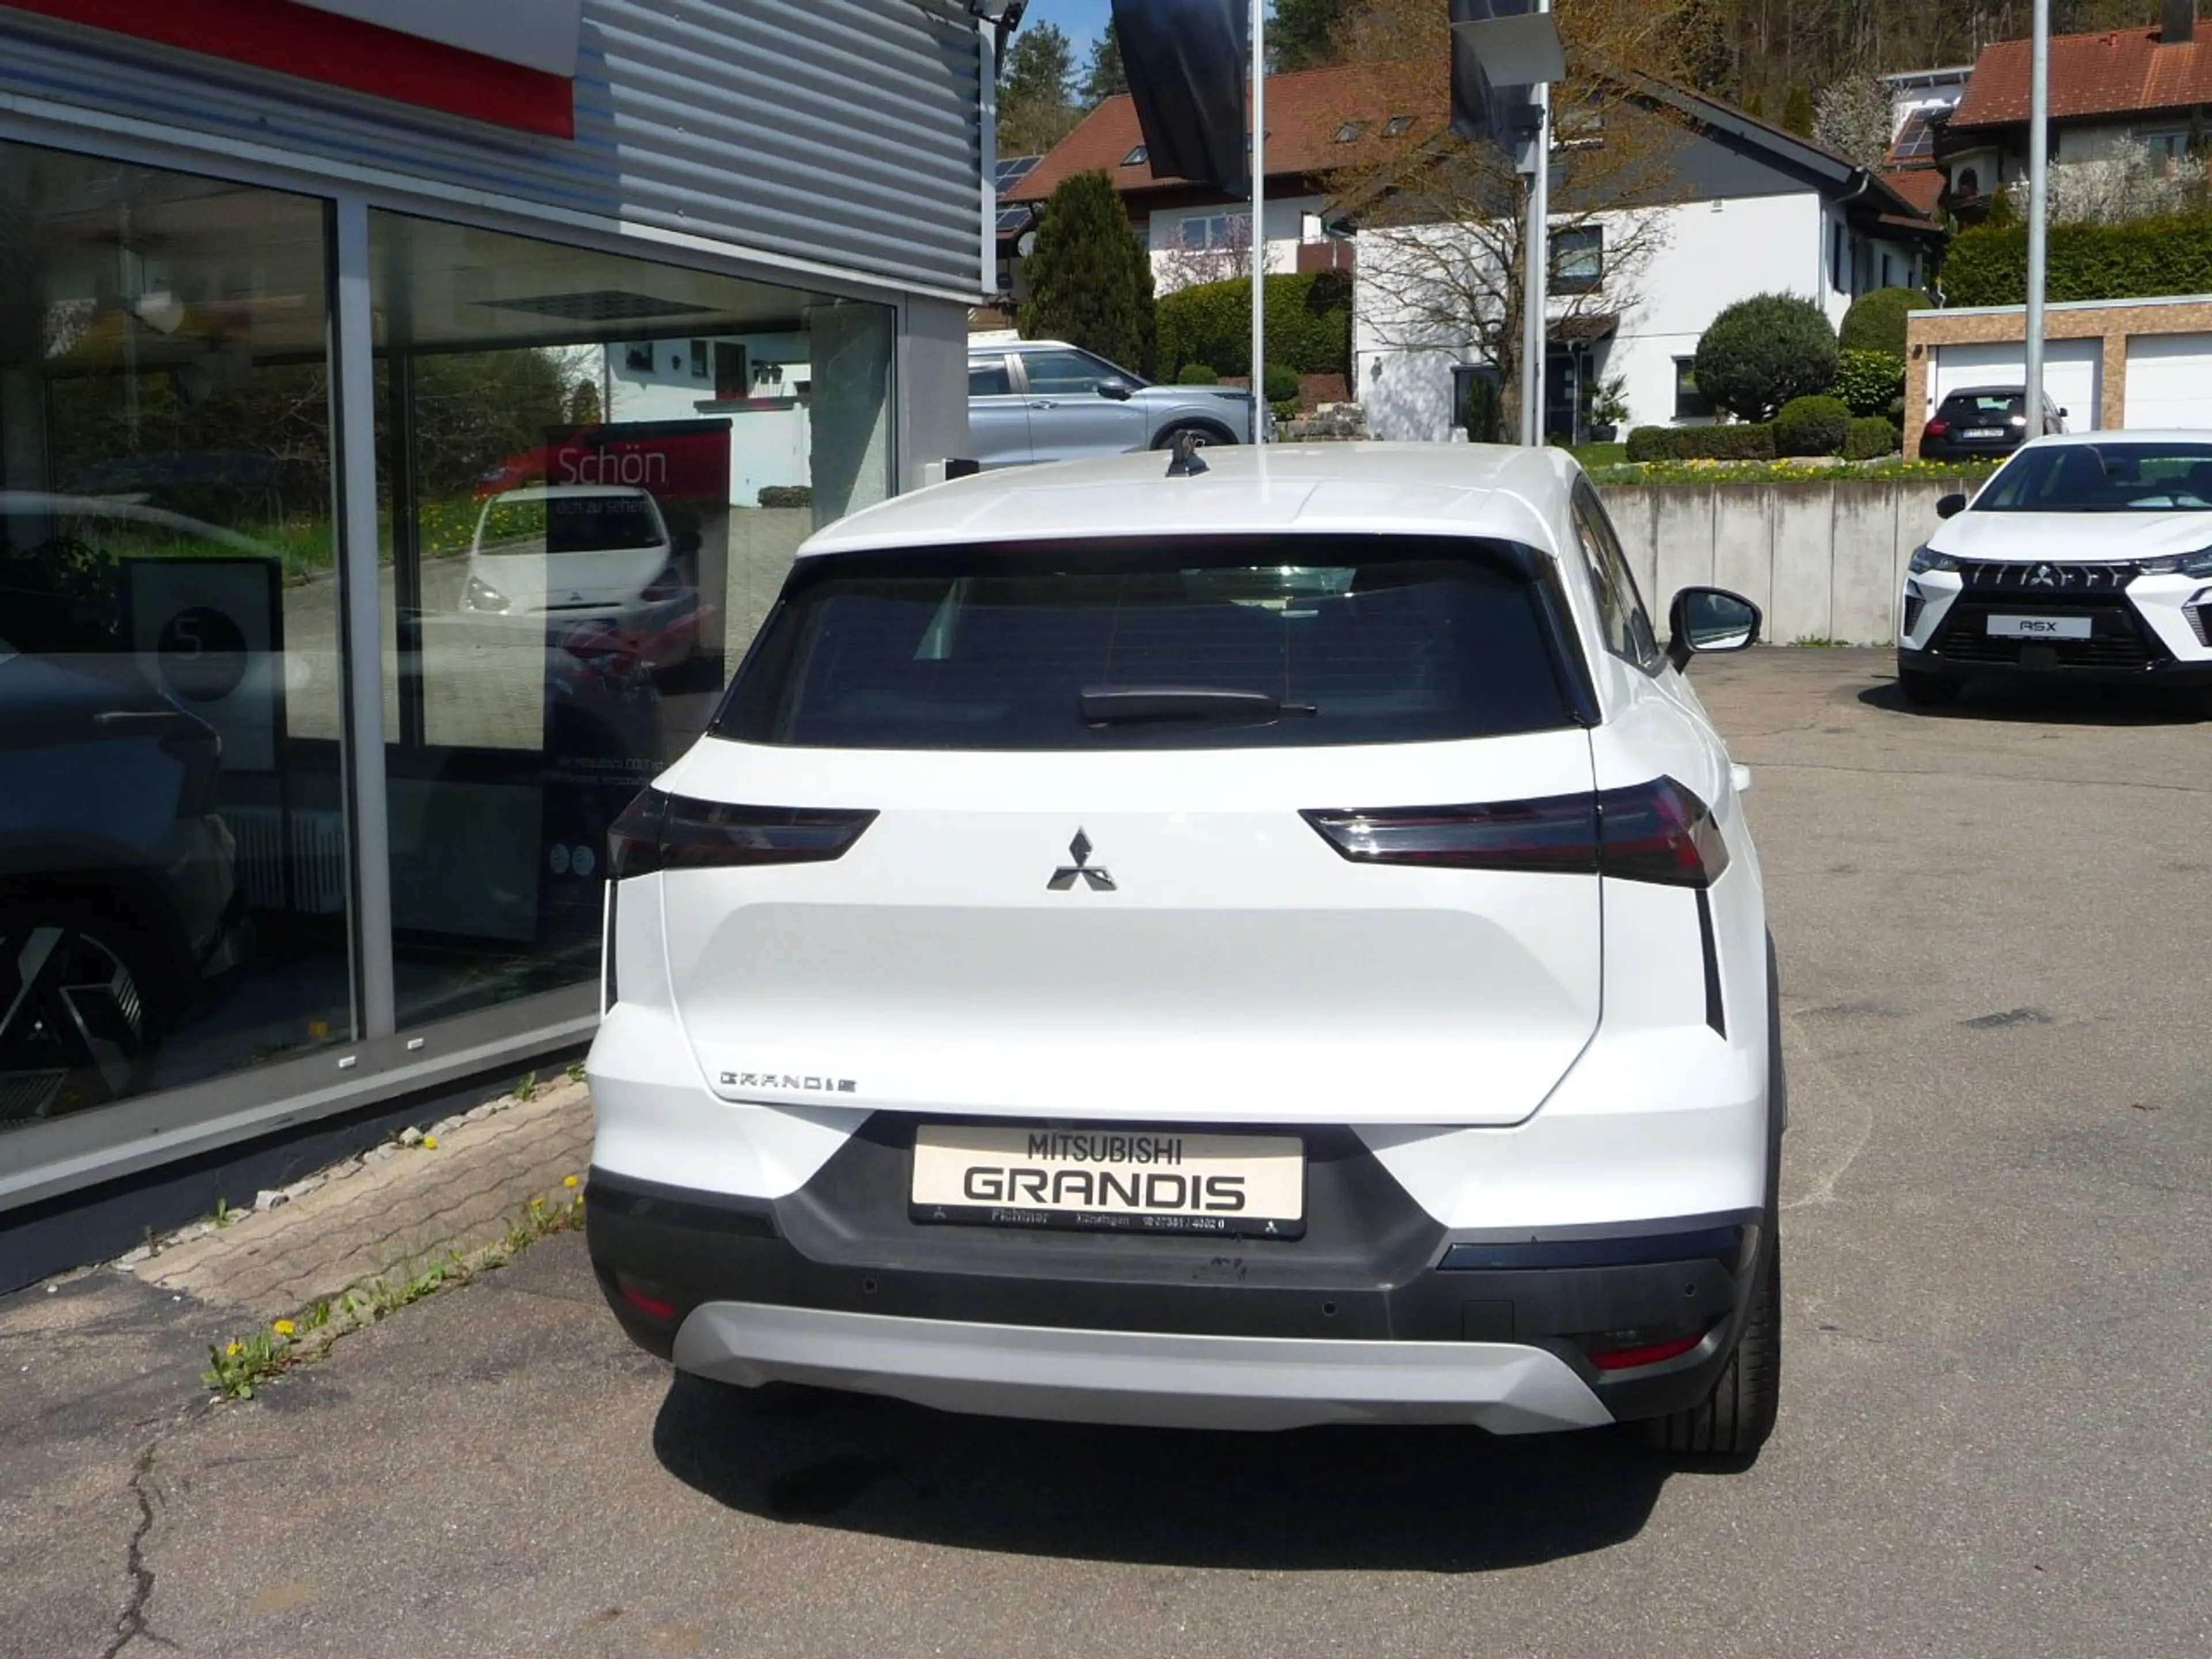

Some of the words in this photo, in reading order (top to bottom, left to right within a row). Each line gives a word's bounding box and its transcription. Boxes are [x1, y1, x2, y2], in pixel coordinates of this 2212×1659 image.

[175, 618, 202, 660] 5
[1027, 1132, 1181, 1165] MITSUBISHI
[964, 1166, 1245, 1211] GRANDIS
